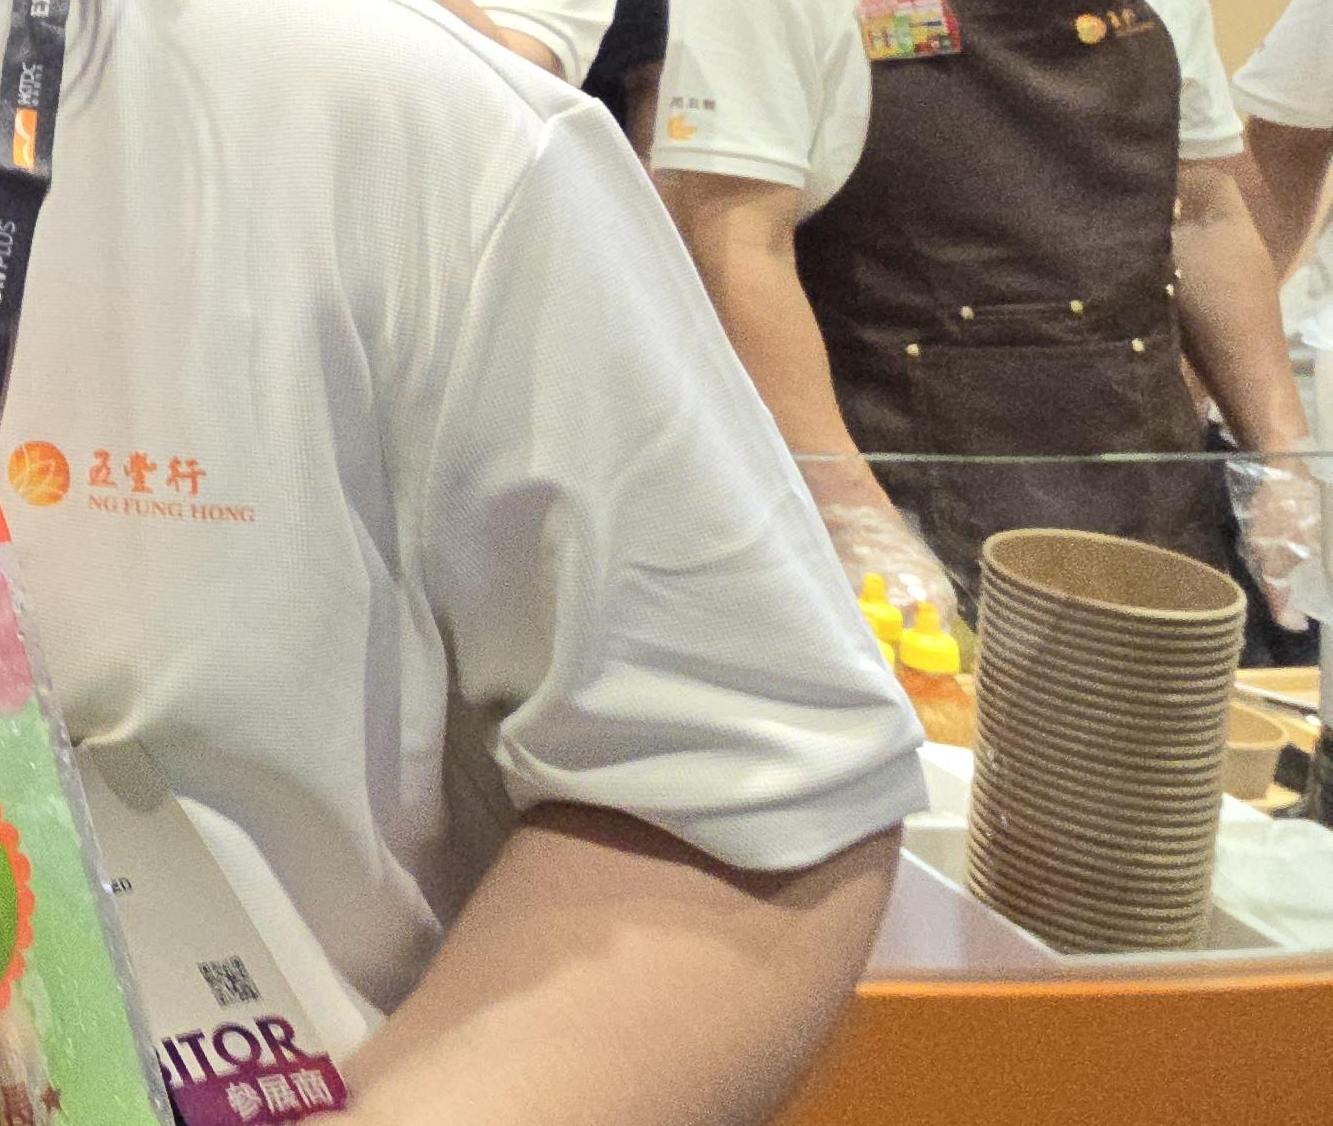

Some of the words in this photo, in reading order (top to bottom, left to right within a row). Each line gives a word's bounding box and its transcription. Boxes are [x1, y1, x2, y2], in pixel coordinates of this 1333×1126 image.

[88, 448, 207, 496] 五豐行
[89, 495, 118, 512] NG
[124, 499, 182, 519] FUNG
[189, 504, 256, 523] HONG
